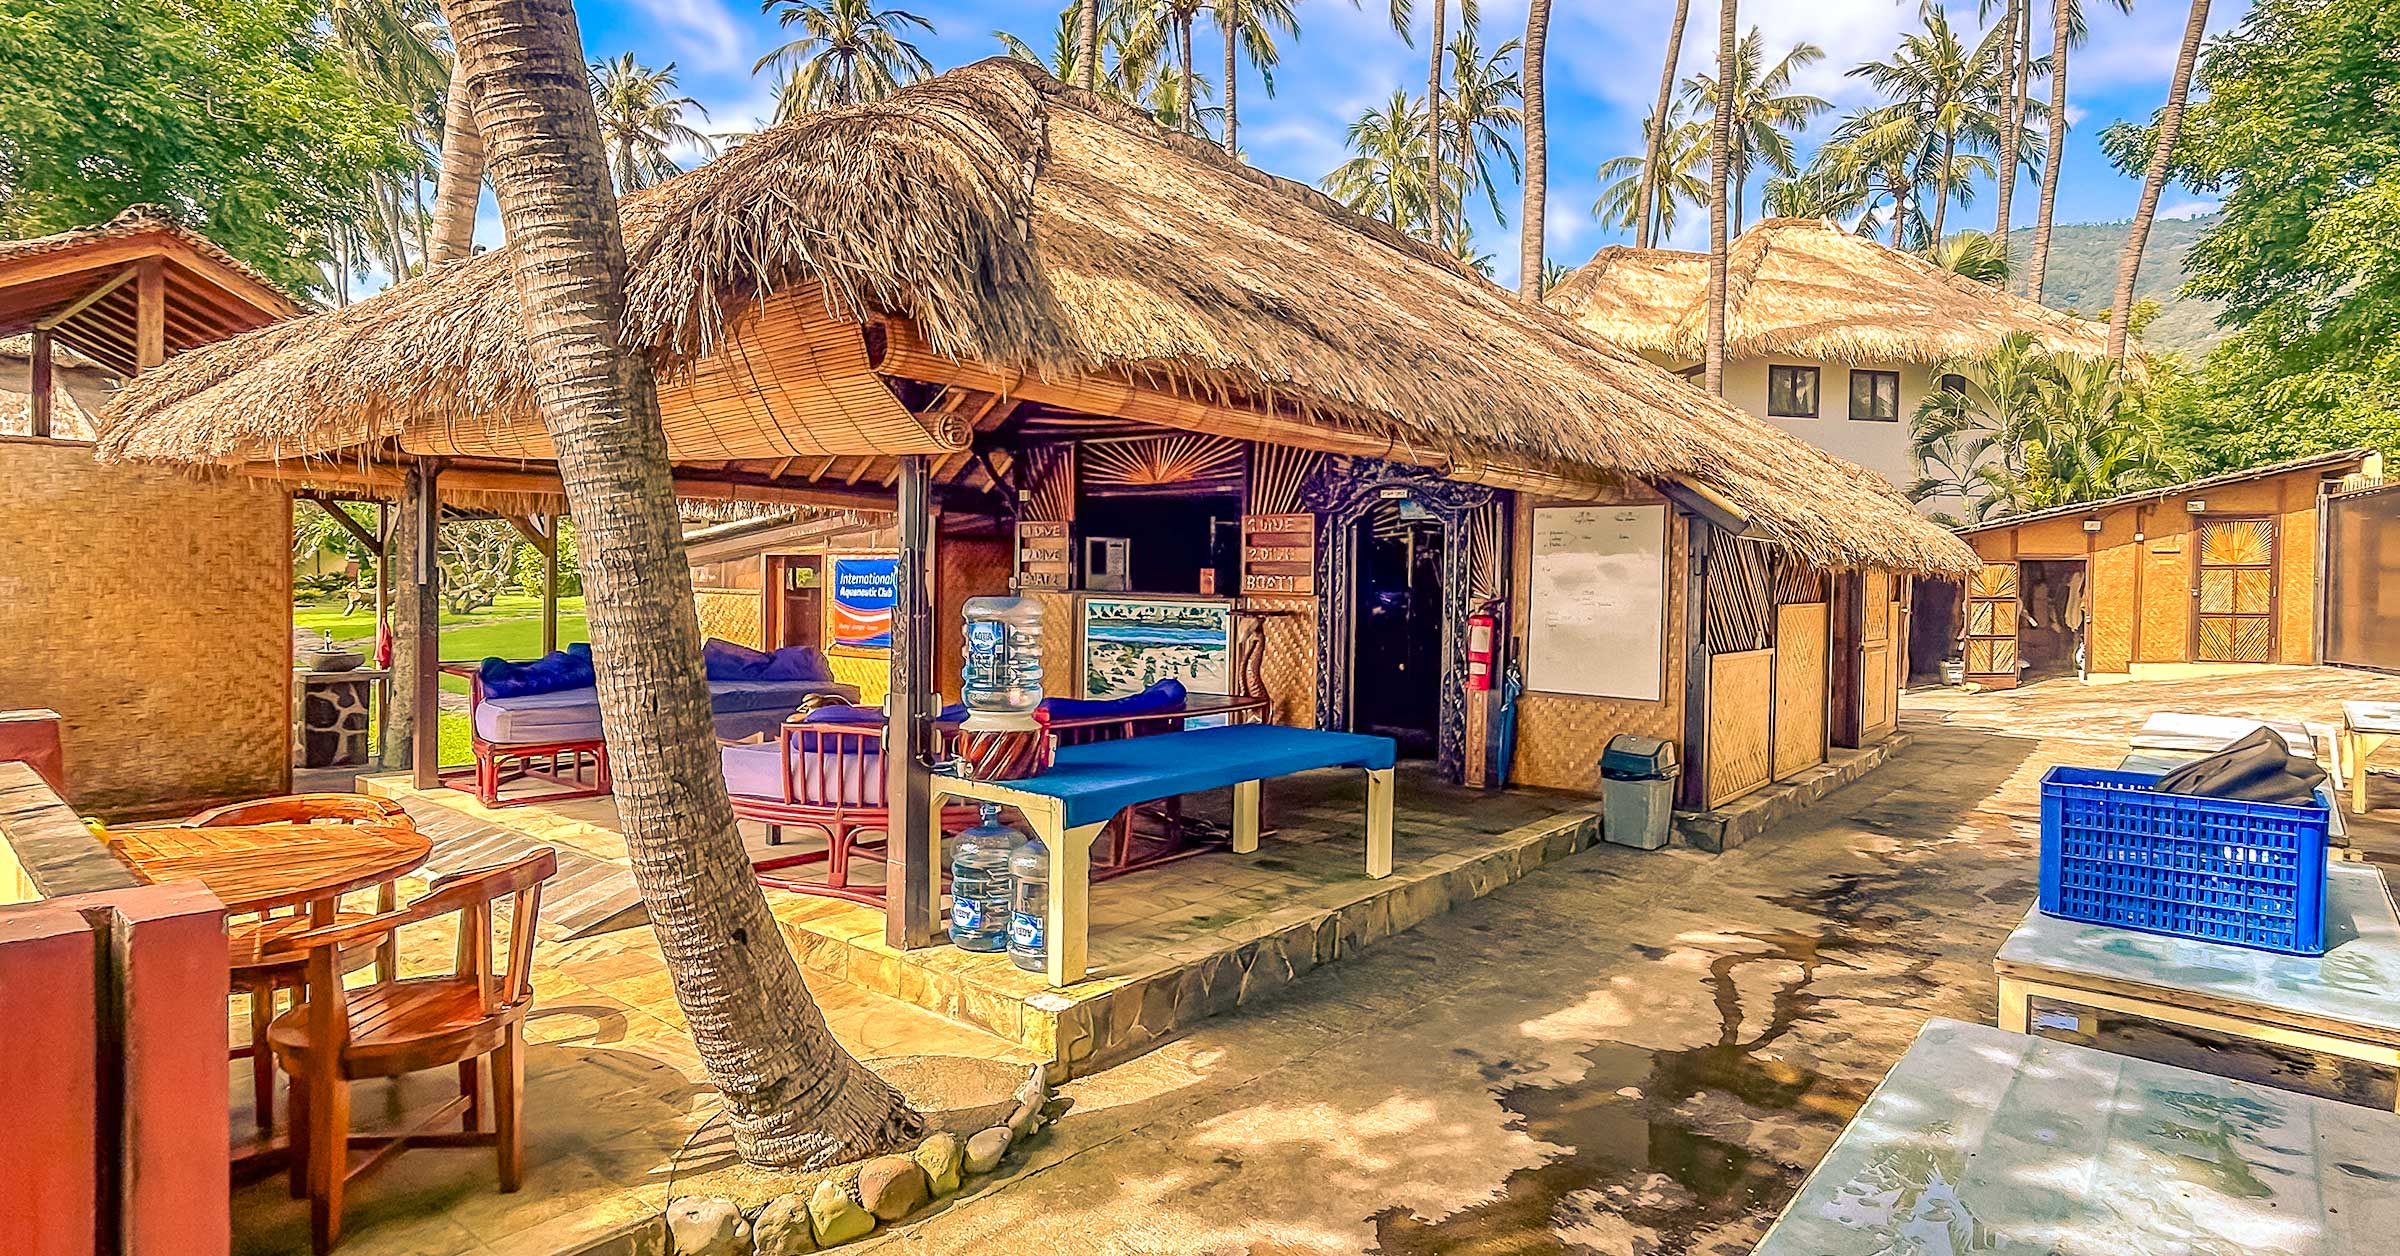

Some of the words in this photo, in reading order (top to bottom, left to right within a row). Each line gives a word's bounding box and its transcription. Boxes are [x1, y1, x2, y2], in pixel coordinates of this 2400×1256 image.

[1034, 525, 1061, 537] DIVE
[1260, 518, 1294, 532] DIVE
[840, 572, 894, 585] International
[878, 587, 893, 597] Club
